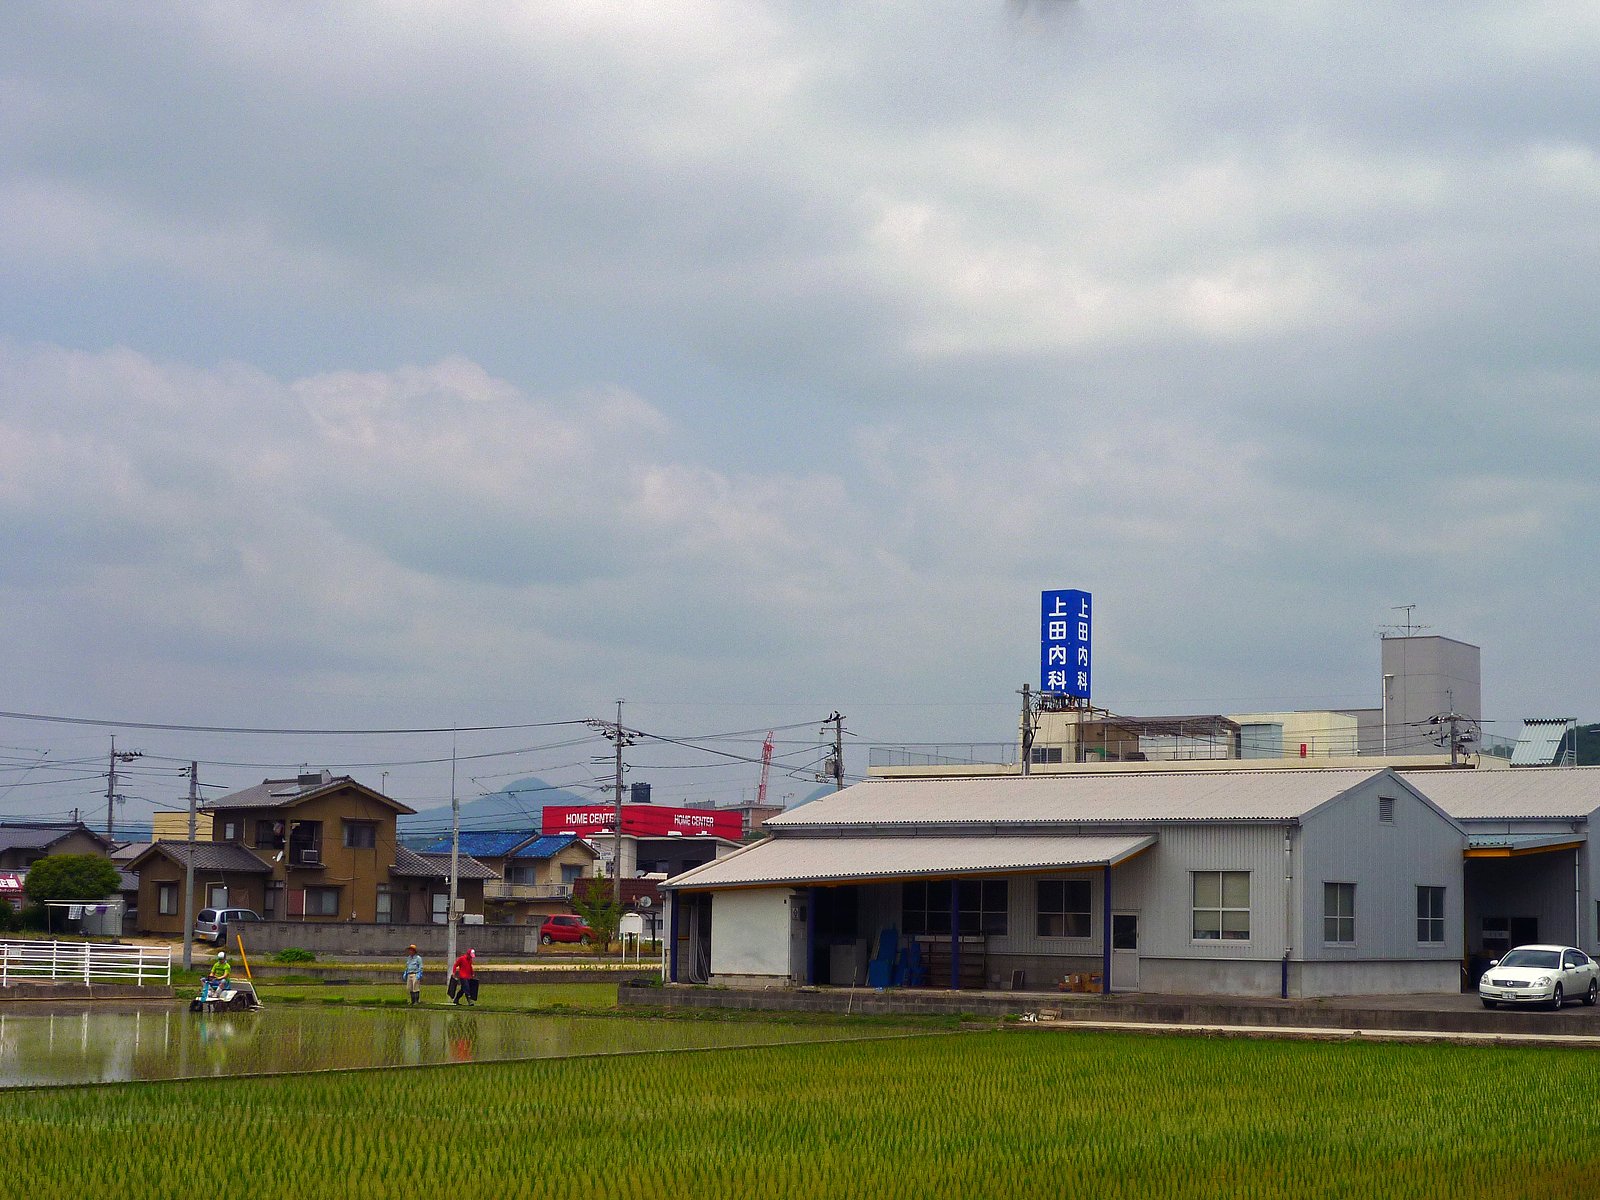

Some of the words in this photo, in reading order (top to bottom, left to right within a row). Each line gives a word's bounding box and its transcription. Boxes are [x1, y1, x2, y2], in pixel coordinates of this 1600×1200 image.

[1048, 597, 1067, 690] 上田内科
[1077, 598, 1088, 692] 上田内科
[565, 813, 588, 824] HOME
[589, 813, 616, 824] CENTE
[674, 814, 691, 826] HOME
[691, 816, 714, 827] CENTER
